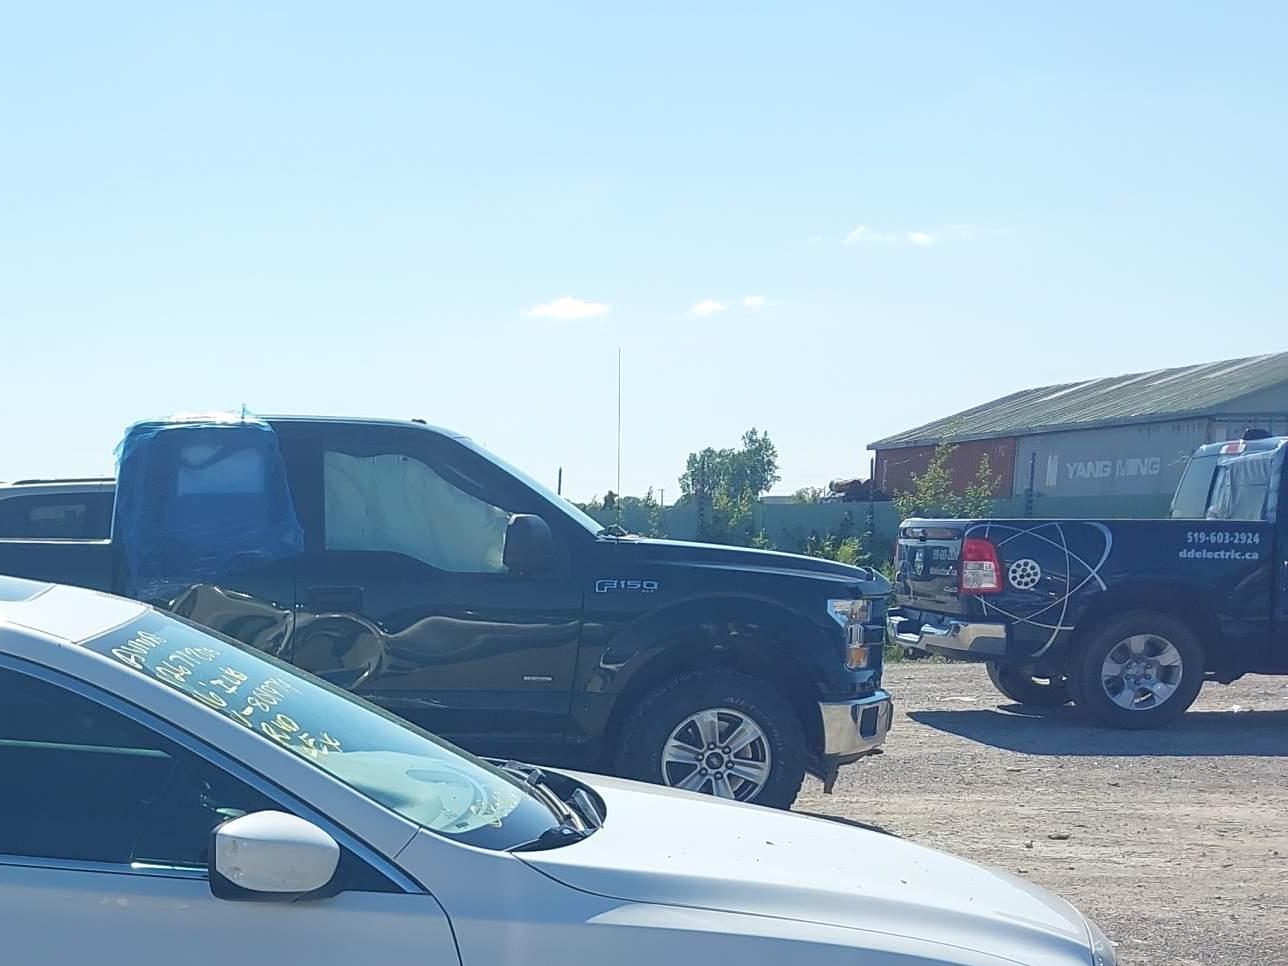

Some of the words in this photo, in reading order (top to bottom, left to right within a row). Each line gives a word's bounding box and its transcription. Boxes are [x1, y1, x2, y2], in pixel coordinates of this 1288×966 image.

[1066, 460, 1112, 480] YANG
[1115, 456, 1161, 477] MING
[1179, 549, 1259, 560] ddelectric.ca
